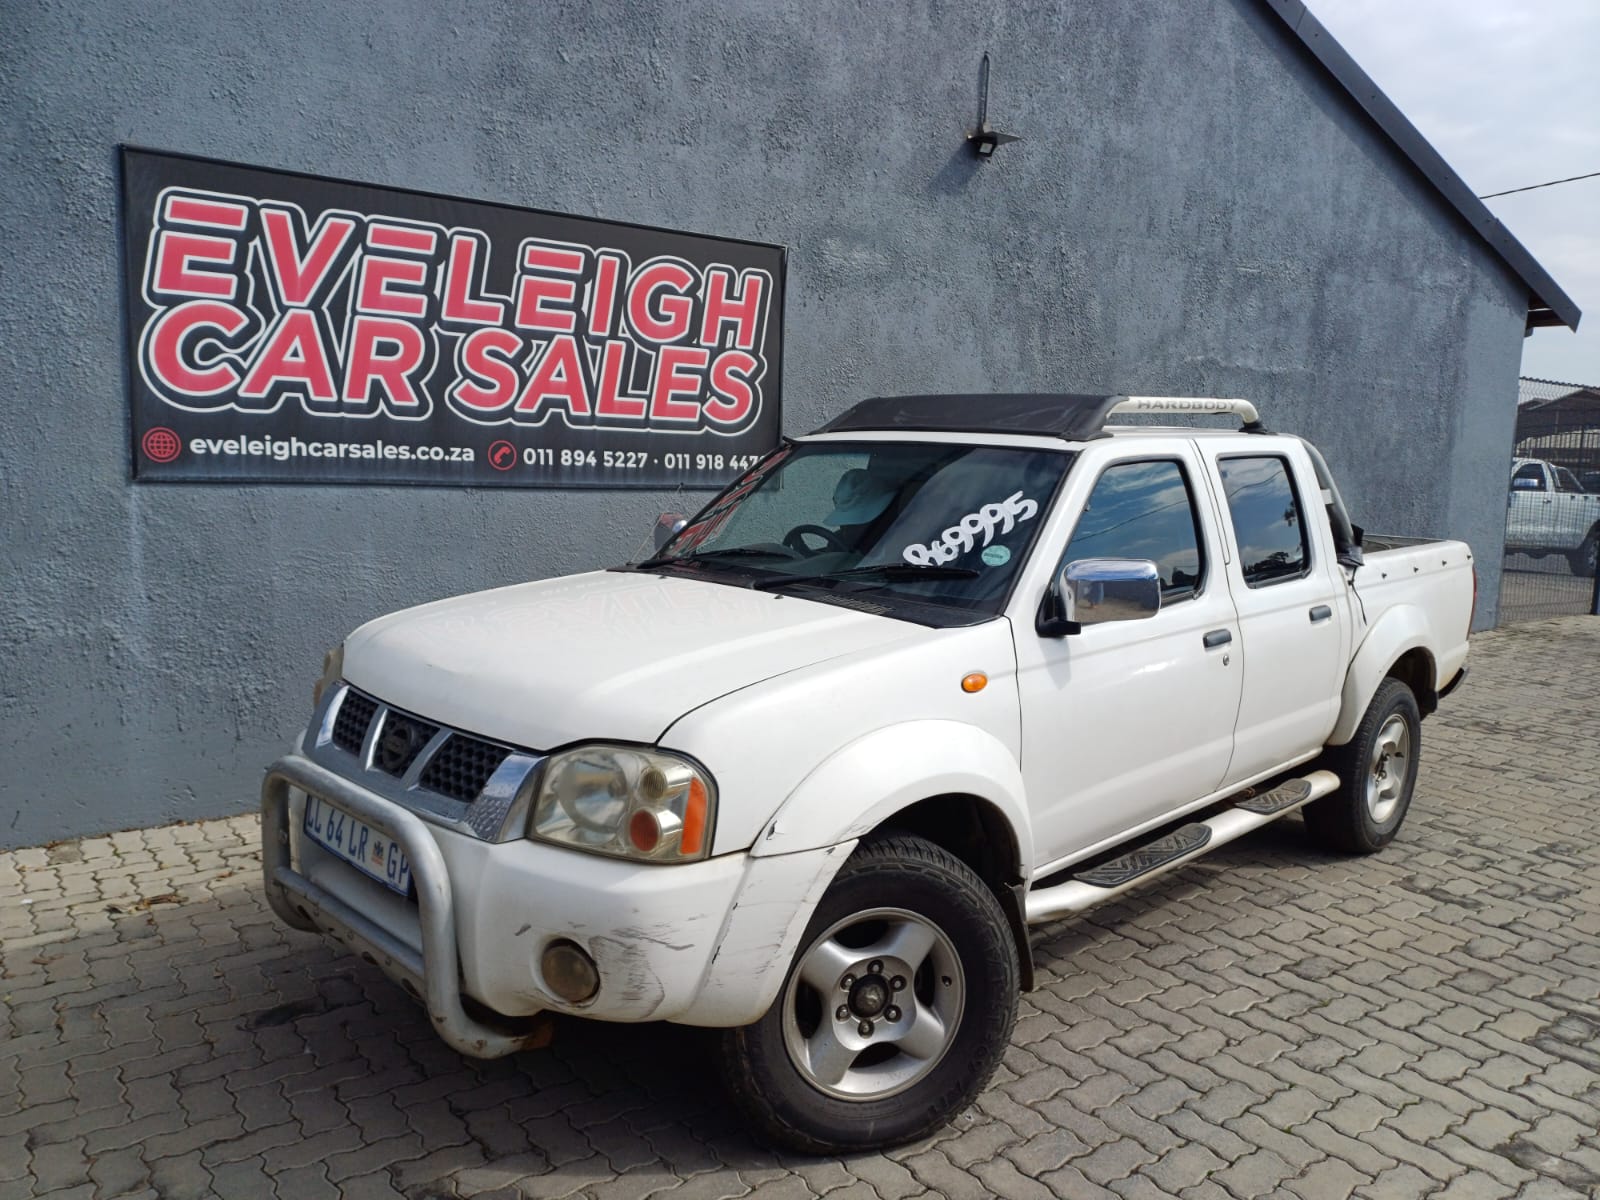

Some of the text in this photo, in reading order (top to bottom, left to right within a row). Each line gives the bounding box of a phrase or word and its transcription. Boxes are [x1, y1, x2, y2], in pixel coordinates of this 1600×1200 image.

[152, 196, 763, 350] EVELEIGH
[151, 300, 759, 425] CAR SALES
[189, 434, 475, 461] eveleighcarsales.co.za
[523, 448, 765, 470] 011 894 5227 011 918 447
[327, 809, 344, 848] 64
[348, 820, 369, 862] LR
